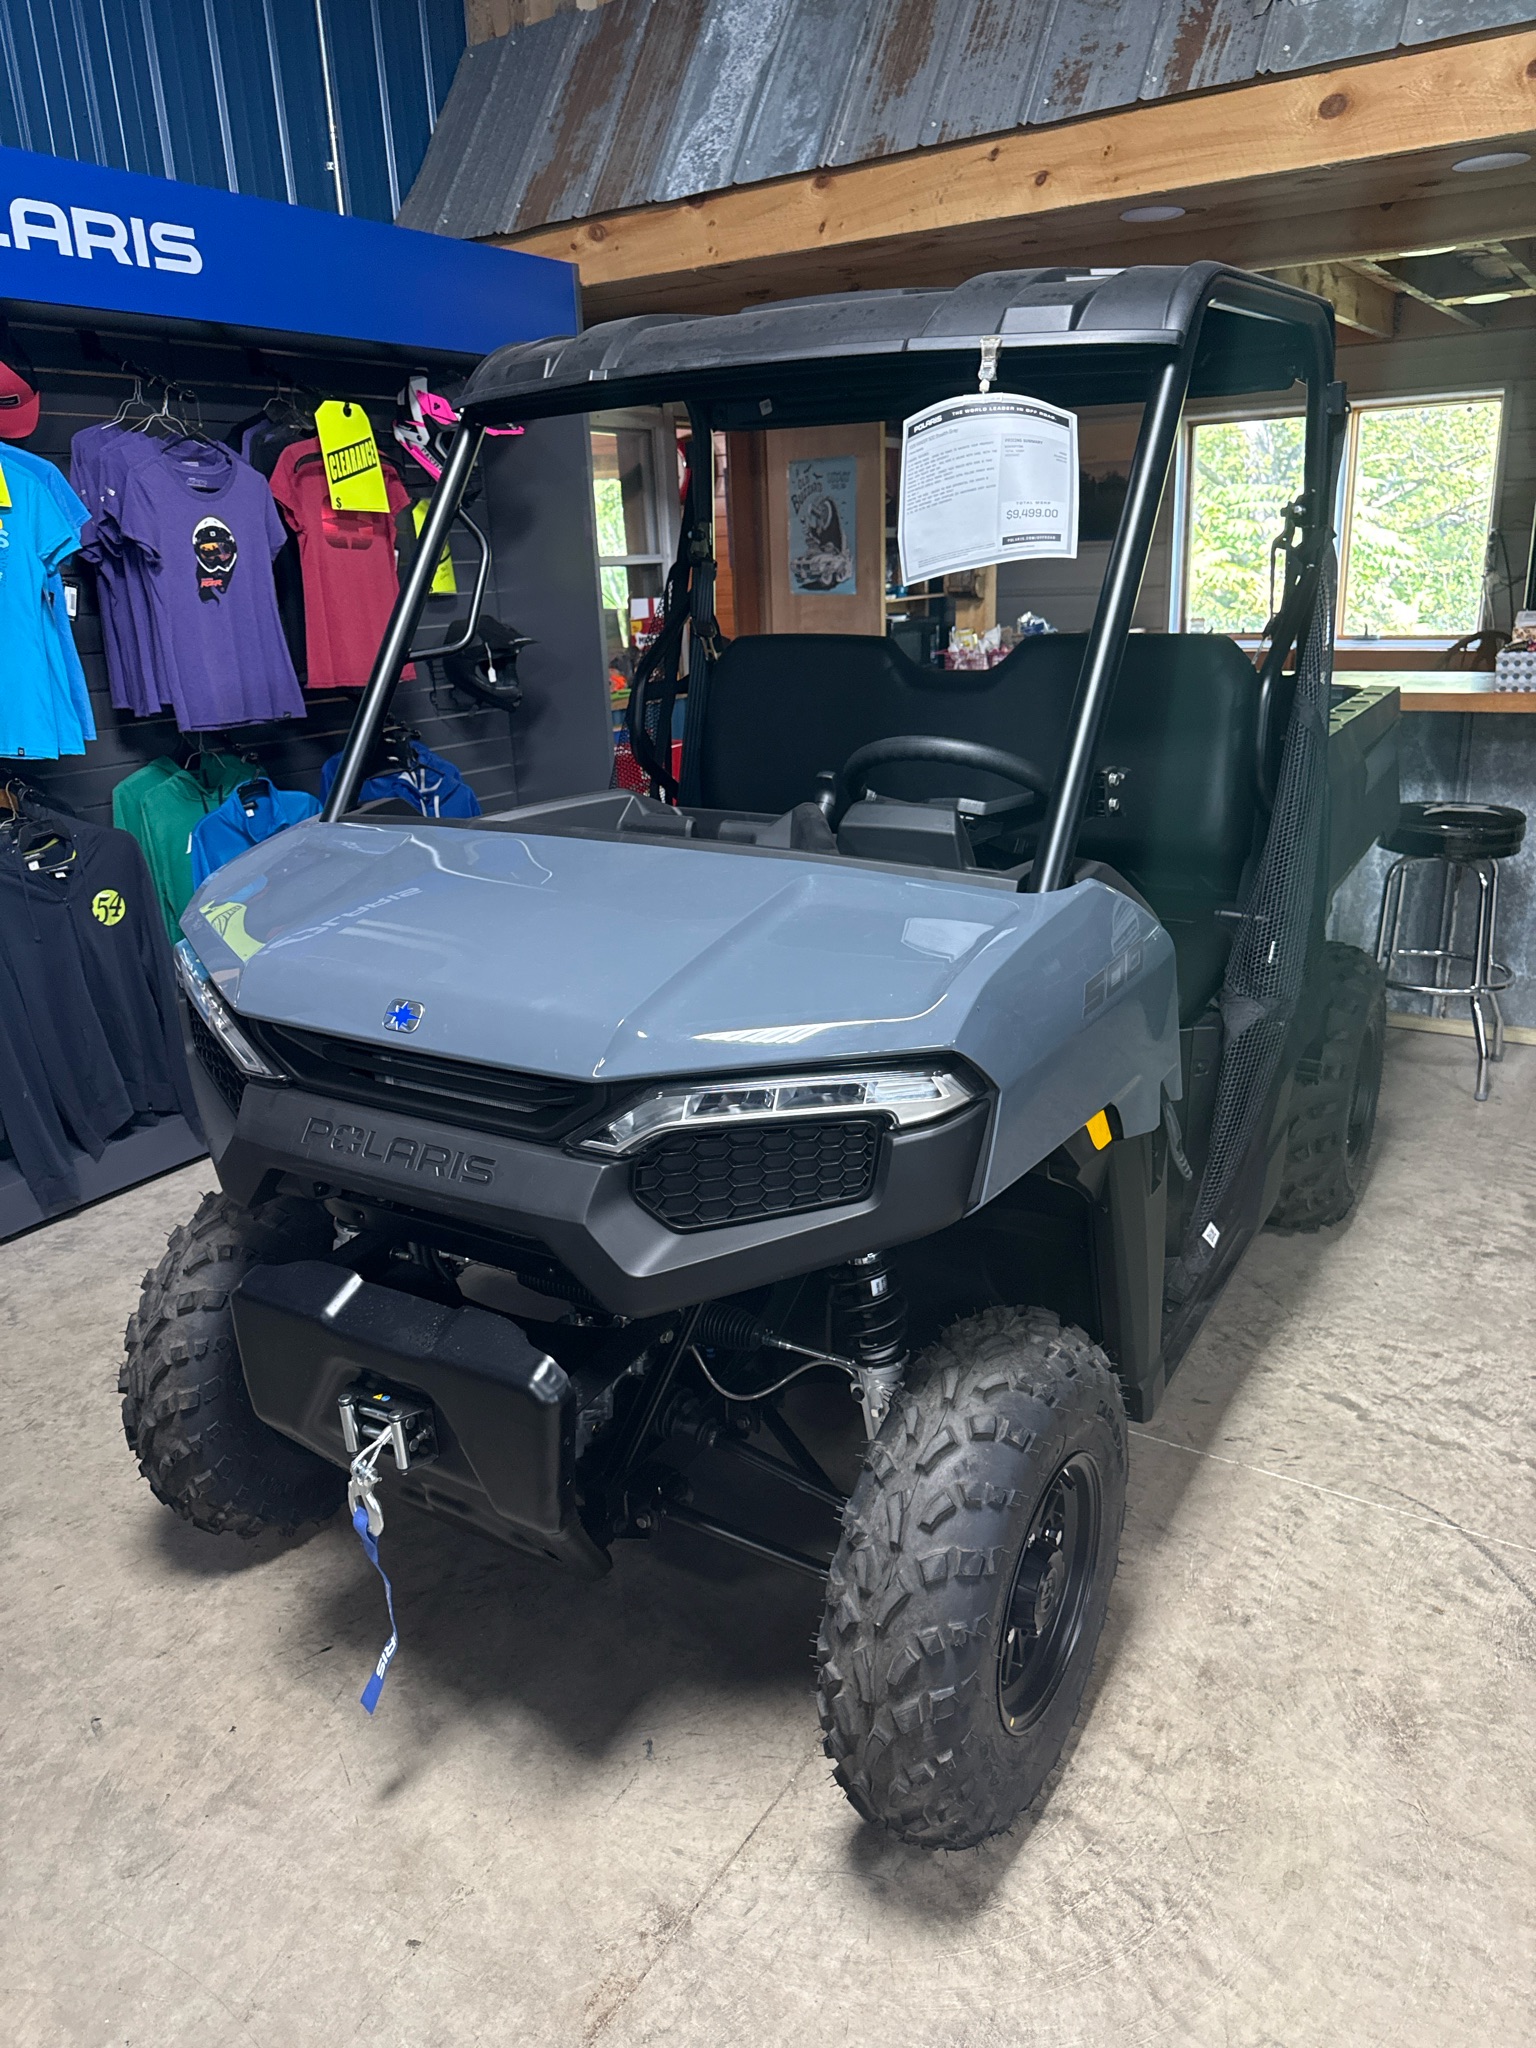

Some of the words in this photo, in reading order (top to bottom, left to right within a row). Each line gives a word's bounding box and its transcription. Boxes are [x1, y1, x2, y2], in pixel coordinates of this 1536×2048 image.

[914, 415, 942, 433] POLARIS
[328, 439, 377, 482] CLEARANCE
[1006, 508, 1059, 520] $9,499.00
[96, 893, 122, 923] 54
[1082, 937, 1145, 1019] 500
[301, 1117, 497, 1187] POLARIS
[376, 1633, 396, 1680] RIS
